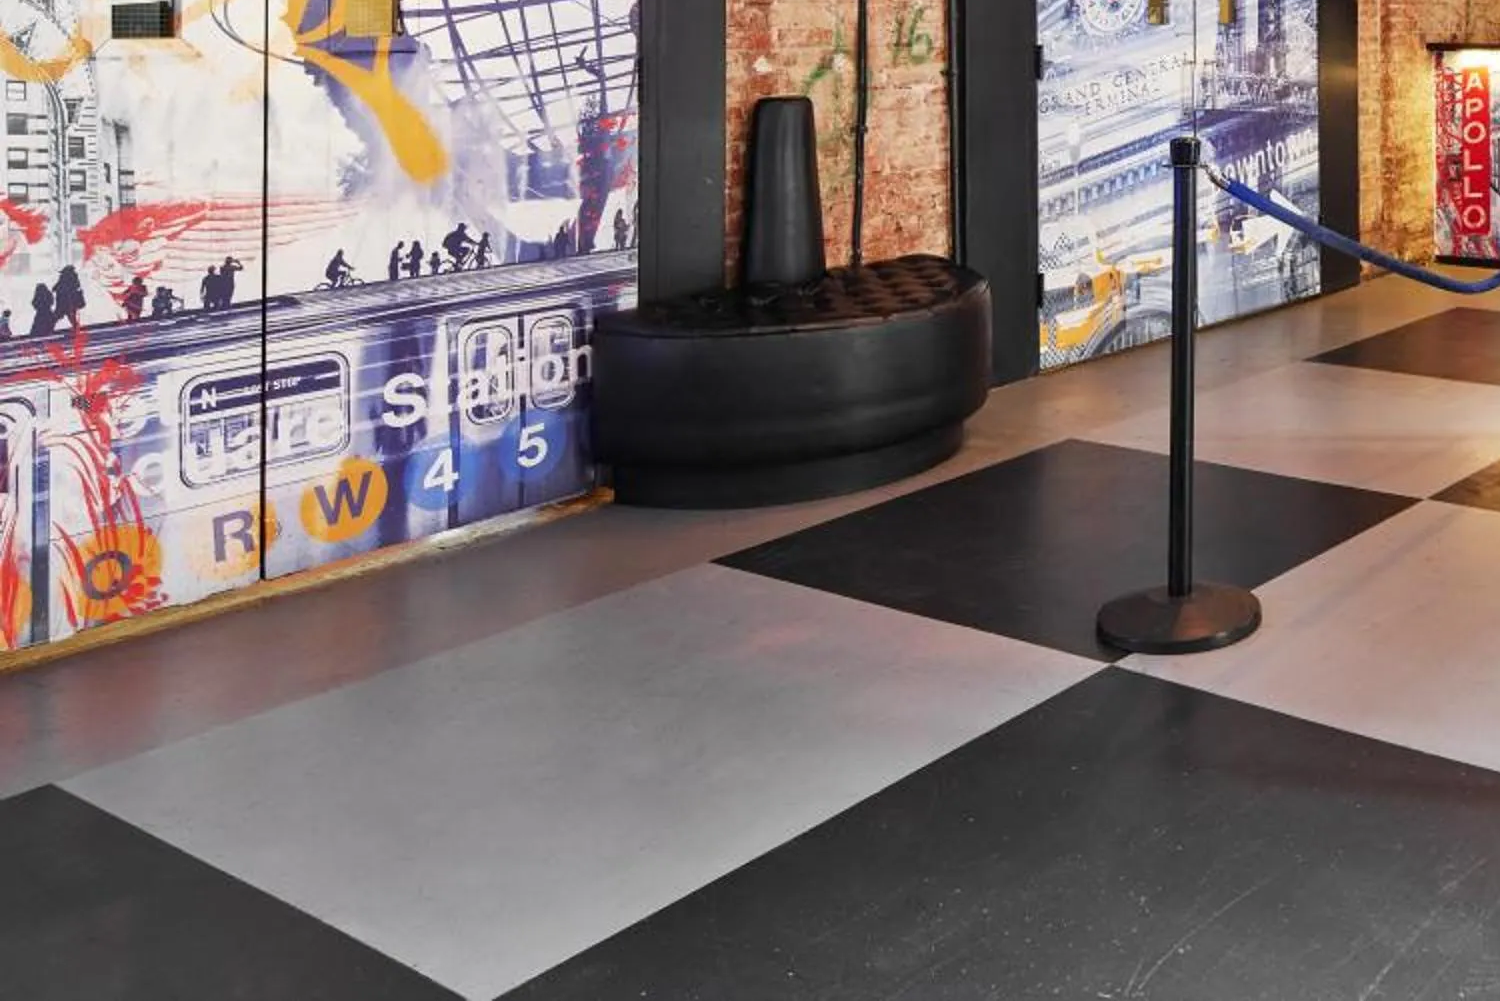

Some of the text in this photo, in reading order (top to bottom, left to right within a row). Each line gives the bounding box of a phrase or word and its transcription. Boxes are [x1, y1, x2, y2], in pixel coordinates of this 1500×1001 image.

[1463, 71, 1486, 229] APOLLO
[211, 509, 258, 563] R
[313, 470, 374, 527] W
[423, 448, 459, 493] 4
[516, 422, 549, 469] 5
